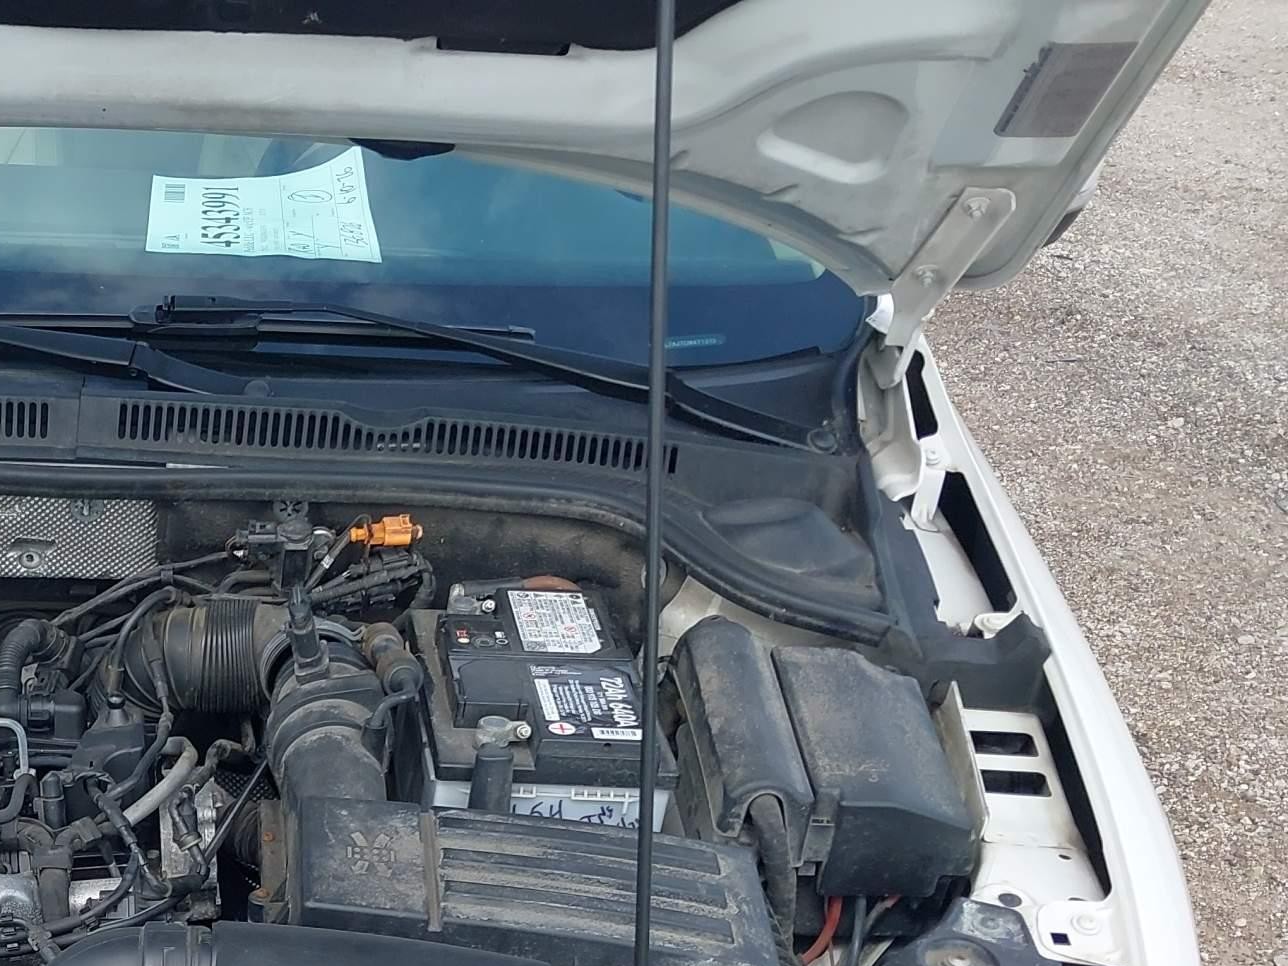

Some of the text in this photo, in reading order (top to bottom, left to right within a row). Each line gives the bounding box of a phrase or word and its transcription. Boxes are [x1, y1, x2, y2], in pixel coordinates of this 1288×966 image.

[200, 186, 240, 247] 45343991
[599, 677, 639, 728] 72Ah 640A
